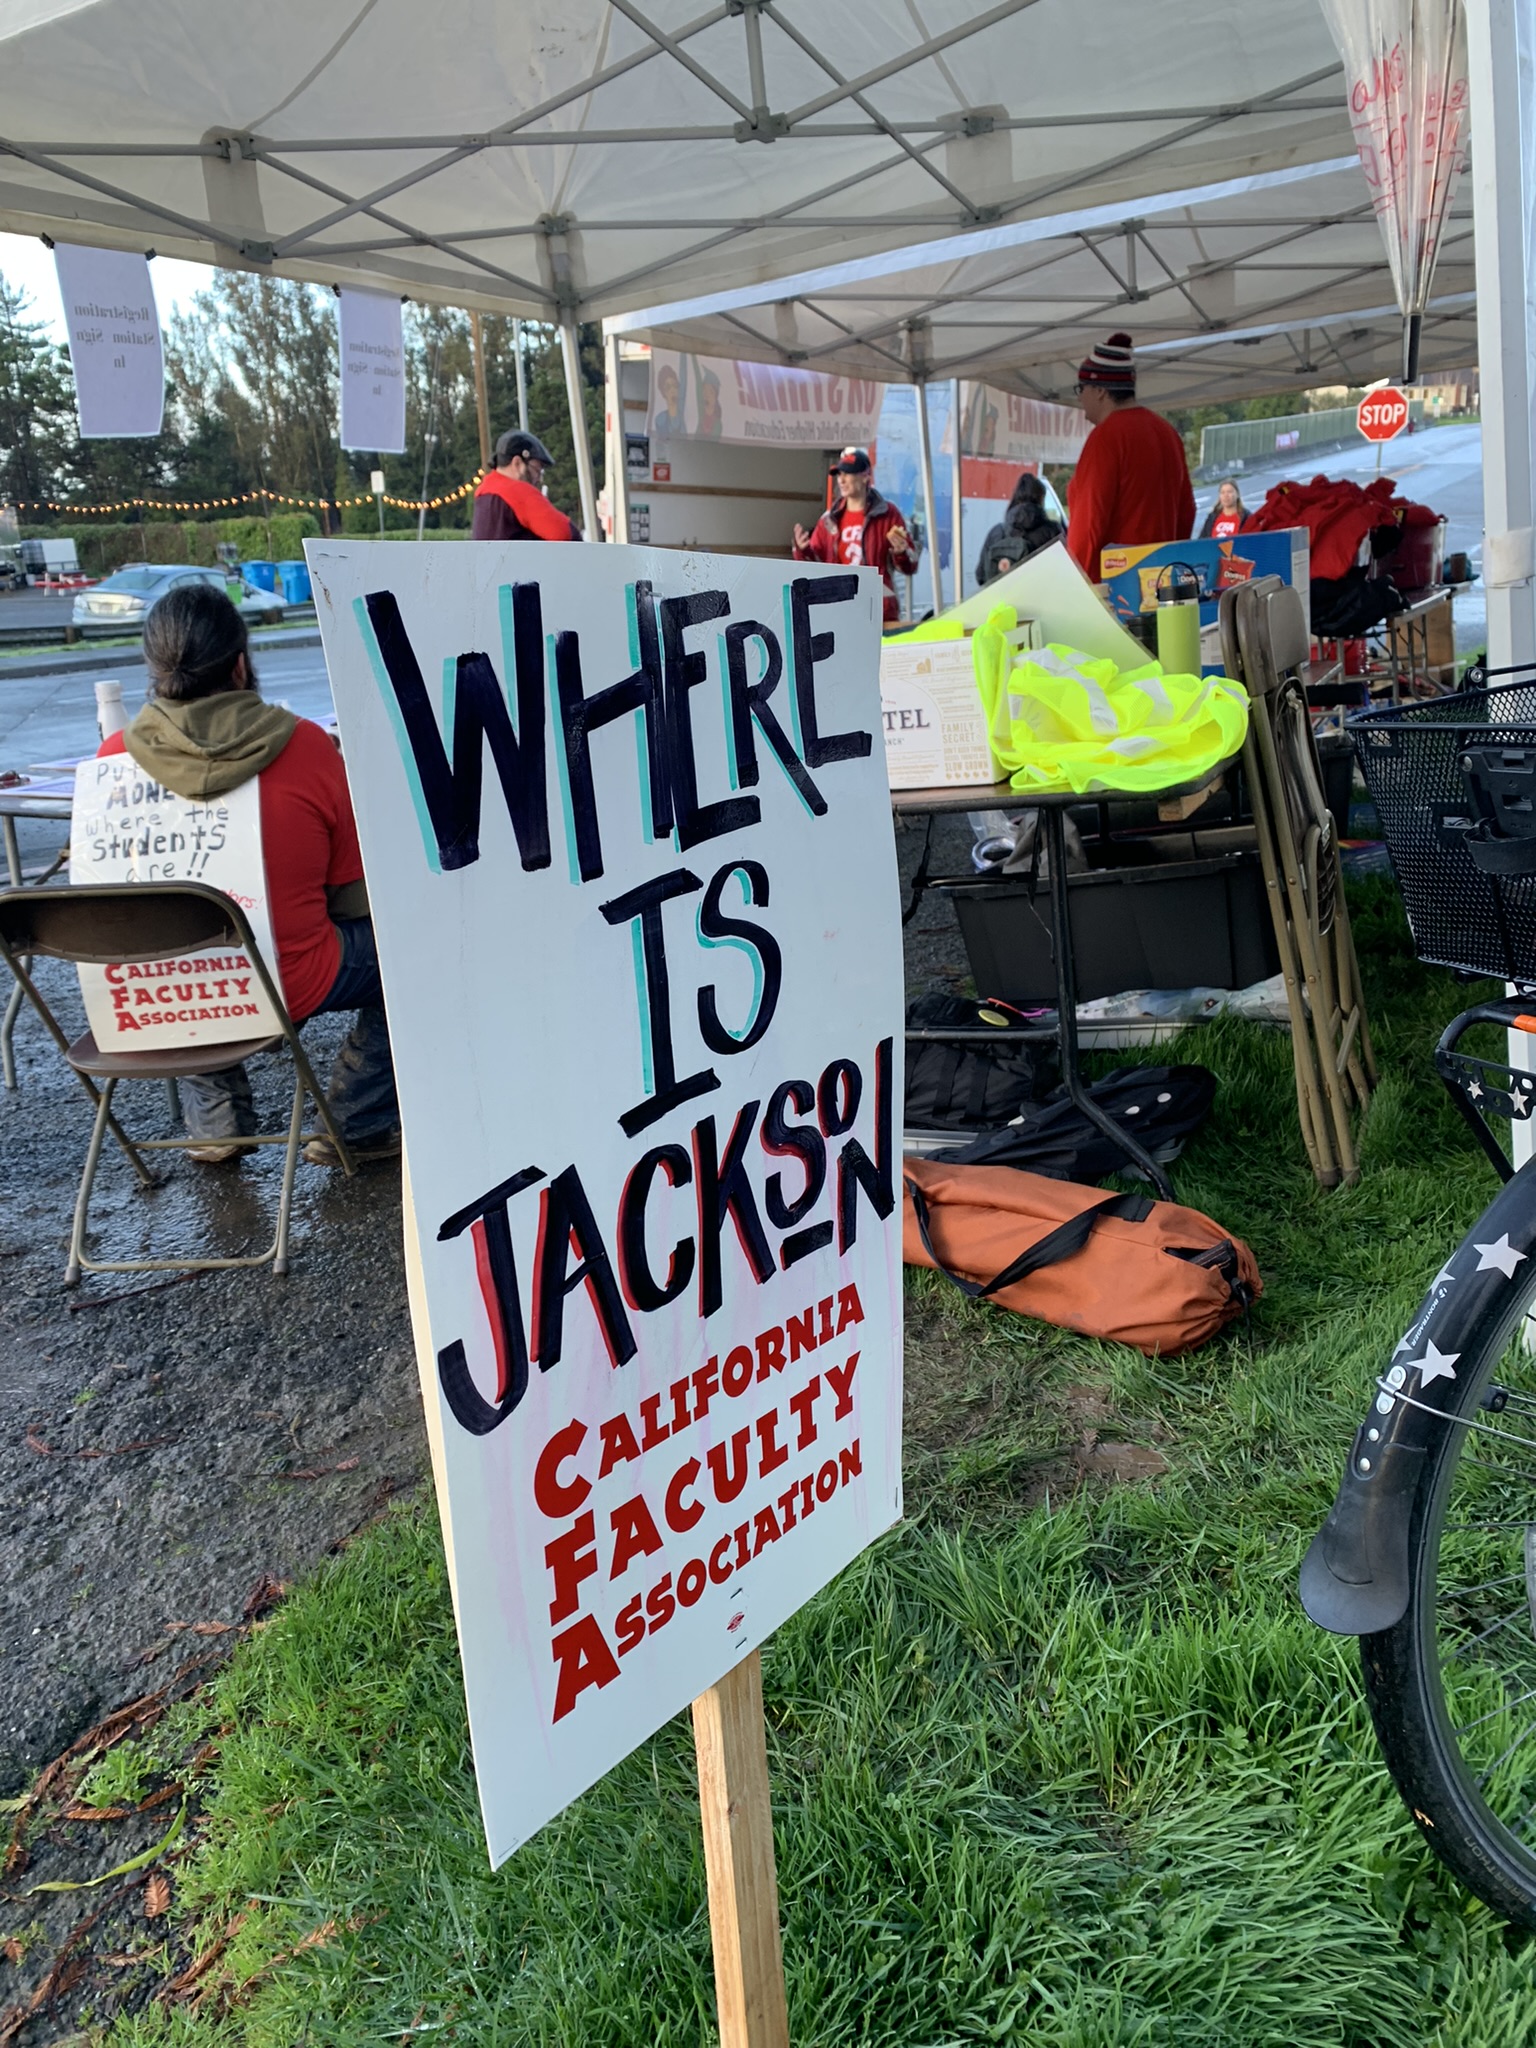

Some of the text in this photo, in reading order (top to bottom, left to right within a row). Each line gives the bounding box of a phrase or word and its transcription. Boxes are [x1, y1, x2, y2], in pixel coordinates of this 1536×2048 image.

[1361, 403, 1406, 426] STOP
[353, 574, 873, 885] WHERE
[941, 722, 974, 734] FAMILY
[942, 732, 975, 744] SECRET
[185, 802, 229, 824] the
[104, 955, 252, 985] CALIFORNIA
[110, 977, 251, 1010] FACULTY
[598, 859, 783, 1138] IS
[115, 1003, 260, 1032] ASSOCIATION
[436, 1036, 896, 1436] JACKSON
[1411, 1298, 1439, 1347] BONTRAGER
[533, 1282, 865, 1519] CALIFORNIA
[543, 1350, 862, 1627] FACULTY
[551, 1437, 863, 1725] ASSOCIATION
